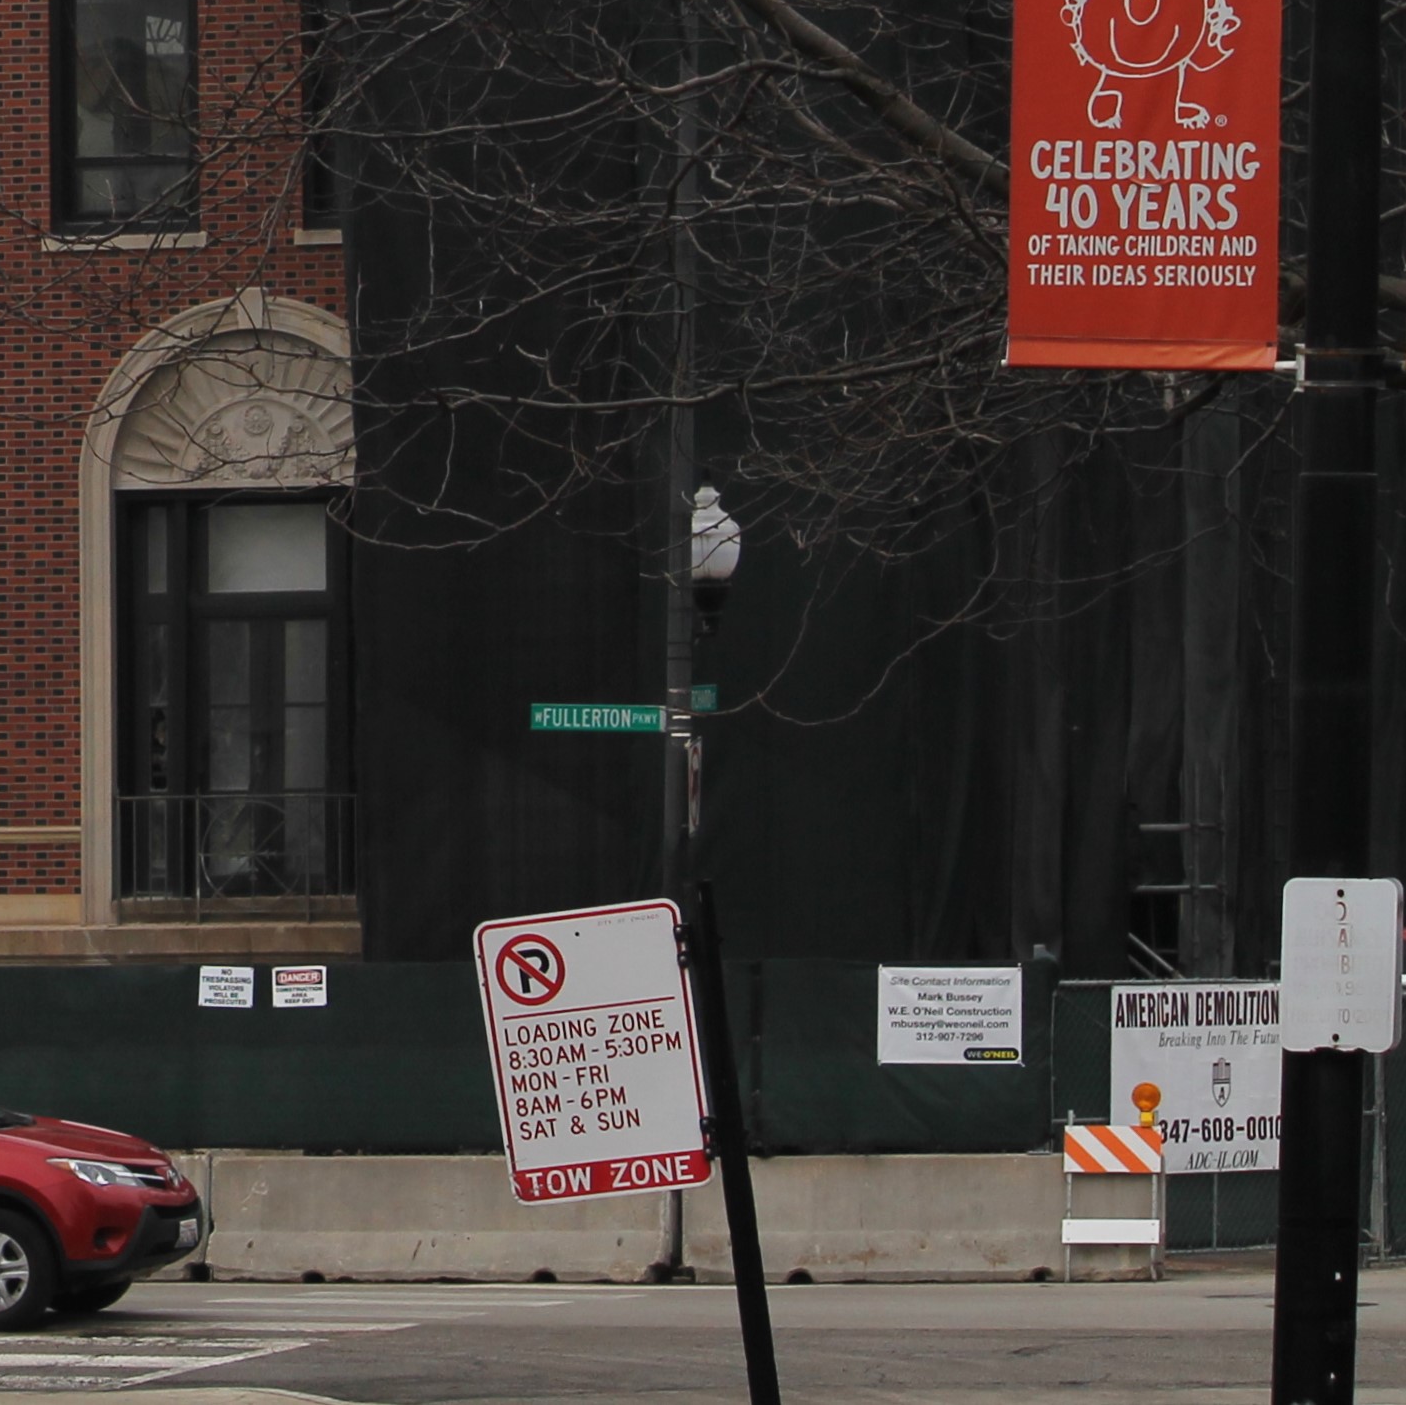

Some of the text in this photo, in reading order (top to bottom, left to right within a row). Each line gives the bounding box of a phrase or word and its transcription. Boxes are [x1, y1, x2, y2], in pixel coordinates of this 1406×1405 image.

[1030, 140, 1260, 180] CELEBRATING
[1045, 182, 1238, 230] 40 YEARS
[1028, 234, 1257, 257] OF TAKING CHILDREN AND
[1027, 264, 1256, 287] THEIR IDEAS SERIOUSLY
[543, 707, 631, 728] FULLERTON
[632, 713, 658, 724] PKWY
[202, 976, 251, 984] TRESPASSING
[280, 973, 317, 982] DANGER
[890, 976, 1011, 986] Site Contact Information
[917, 993, 983, 1003] Mark Bussey
[1115, 991, 1189, 1028] AMERICAN
[1195, 990, 1280, 1027] DEMOLITION
[887, 1007, 1012, 1016] W.E. O'Neil Construction
[504, 1009, 665, 1046] LOADING ZONE
[891, 1020, 1009, 1030] mbussey@weoneil.com
[509, 1031, 682, 1070] 8:30AM 5:30PM
[1159, 1029, 1280, 1049] Breaking Into The Futur
[511, 1064, 610, 1094] MON FRI
[516, 1087, 627, 1117] 8AM 6PM
[520, 1109, 641, 1140] SAT & SUN
[1185, 1150, 1259, 1171] ADC-IL.COM
[526, 1156, 694, 1197] TOW ZONE
